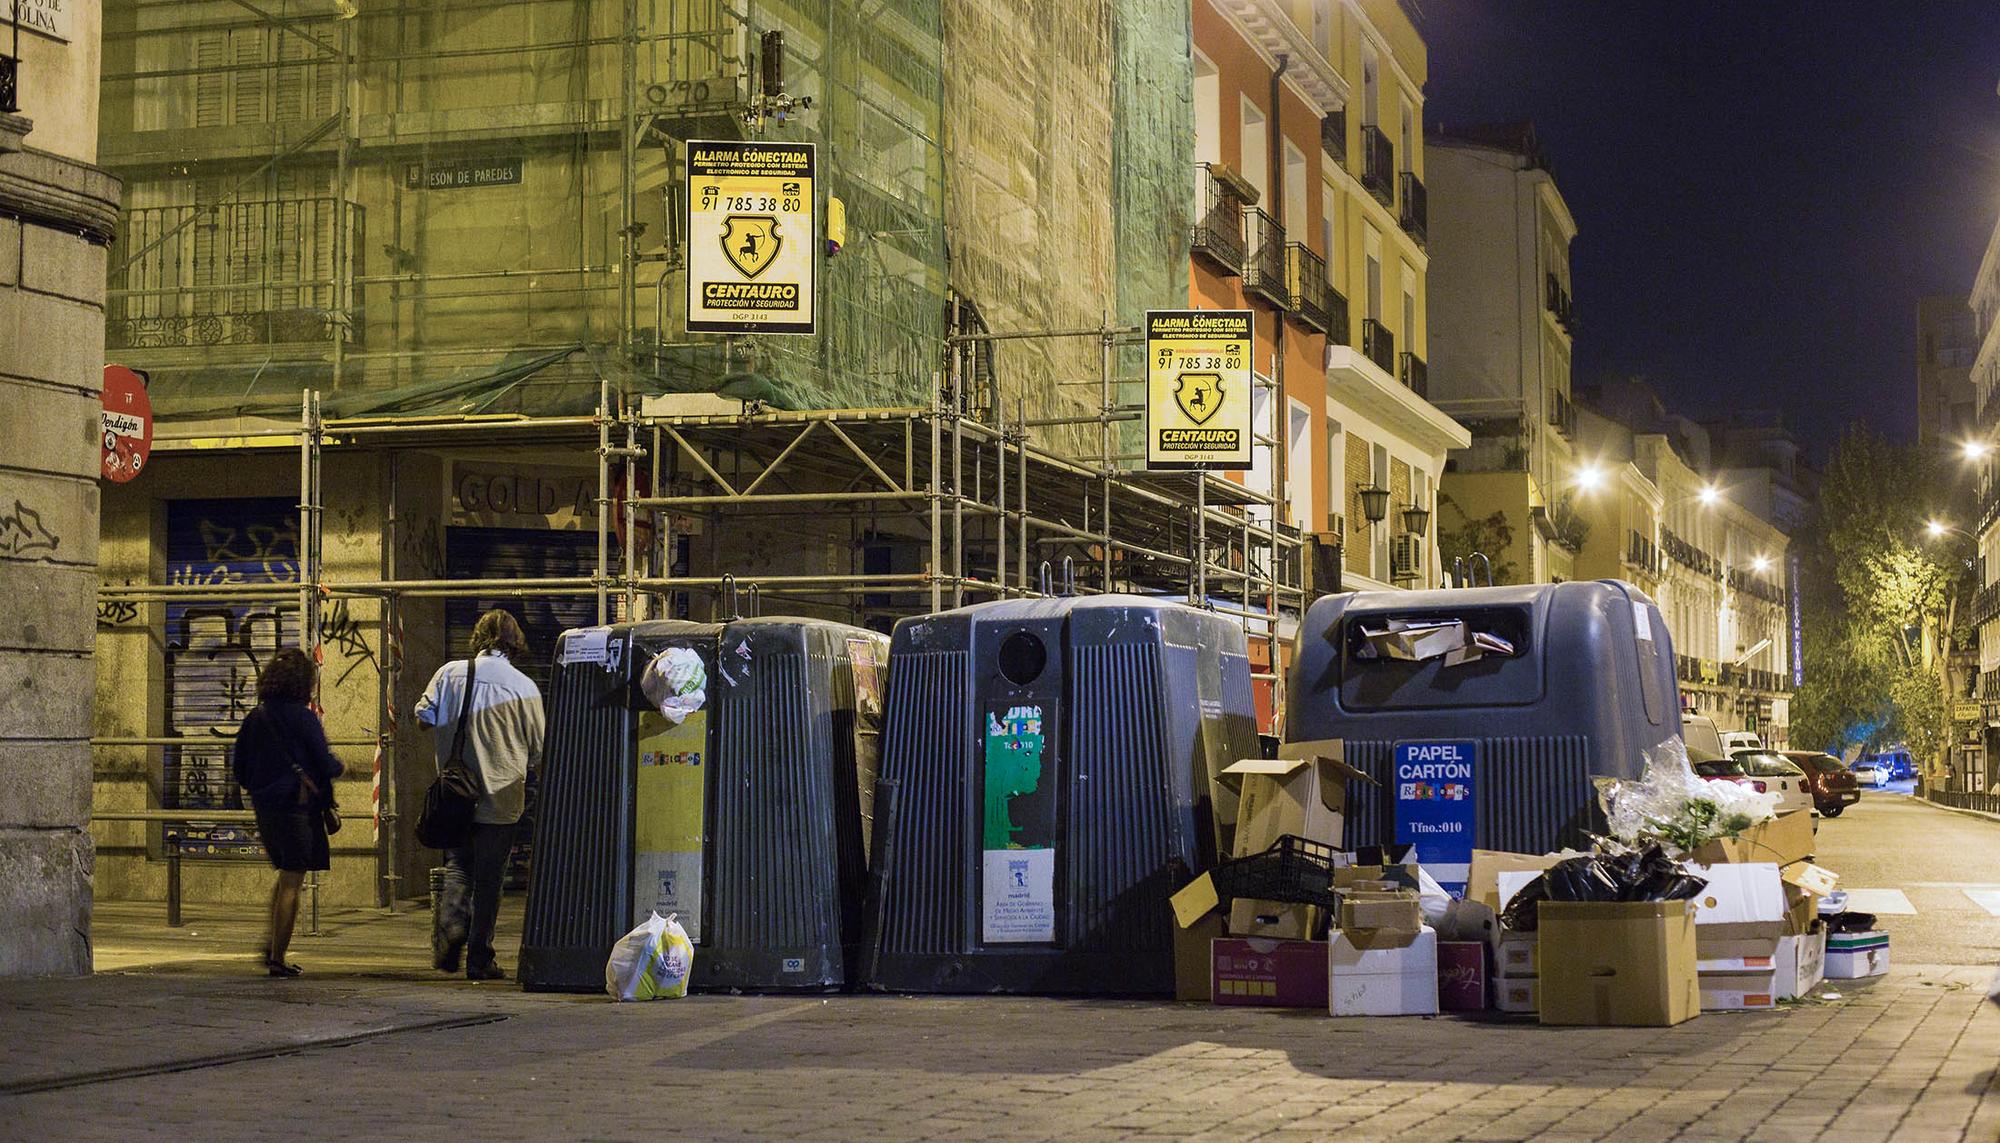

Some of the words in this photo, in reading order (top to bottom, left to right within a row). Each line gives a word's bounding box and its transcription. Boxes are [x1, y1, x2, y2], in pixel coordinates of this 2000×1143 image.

[694, 151, 739, 161] ALARMA
[742, 152, 808, 163] CONECTADA
[430, 171, 453, 186] ESÓN
[457, 171, 470, 184] DE
[474, 167, 513, 182] PAREDES
[702, 196, 718, 211] 91
[726, 197, 753, 211] 785
[759, 198, 777, 211] 38
[782, 198, 801, 212] 80
[705, 284, 796, 299] CENTAURO
[707, 299, 750, 307] PROTECCIÓN
[756, 300, 795, 308] SEGURIDAD
[1152, 318, 1190, 328] ALARMA
[1192, 319, 1247, 328] CONECTADA
[1158, 357, 1172, 369] 91
[1179, 357, 1200, 369] 785
[1205, 357, 1221, 369] 38
[1225, 357, 1241, 369] 80
[1162, 430, 1237, 442] CENTAURO
[459, 473, 557, 515] GOLD
[1408, 746, 1462, 761] PAPEL
[1399, 761, 1470, 779] CARTÓN
[1409, 821, 1462, 833] Tfno.:010
